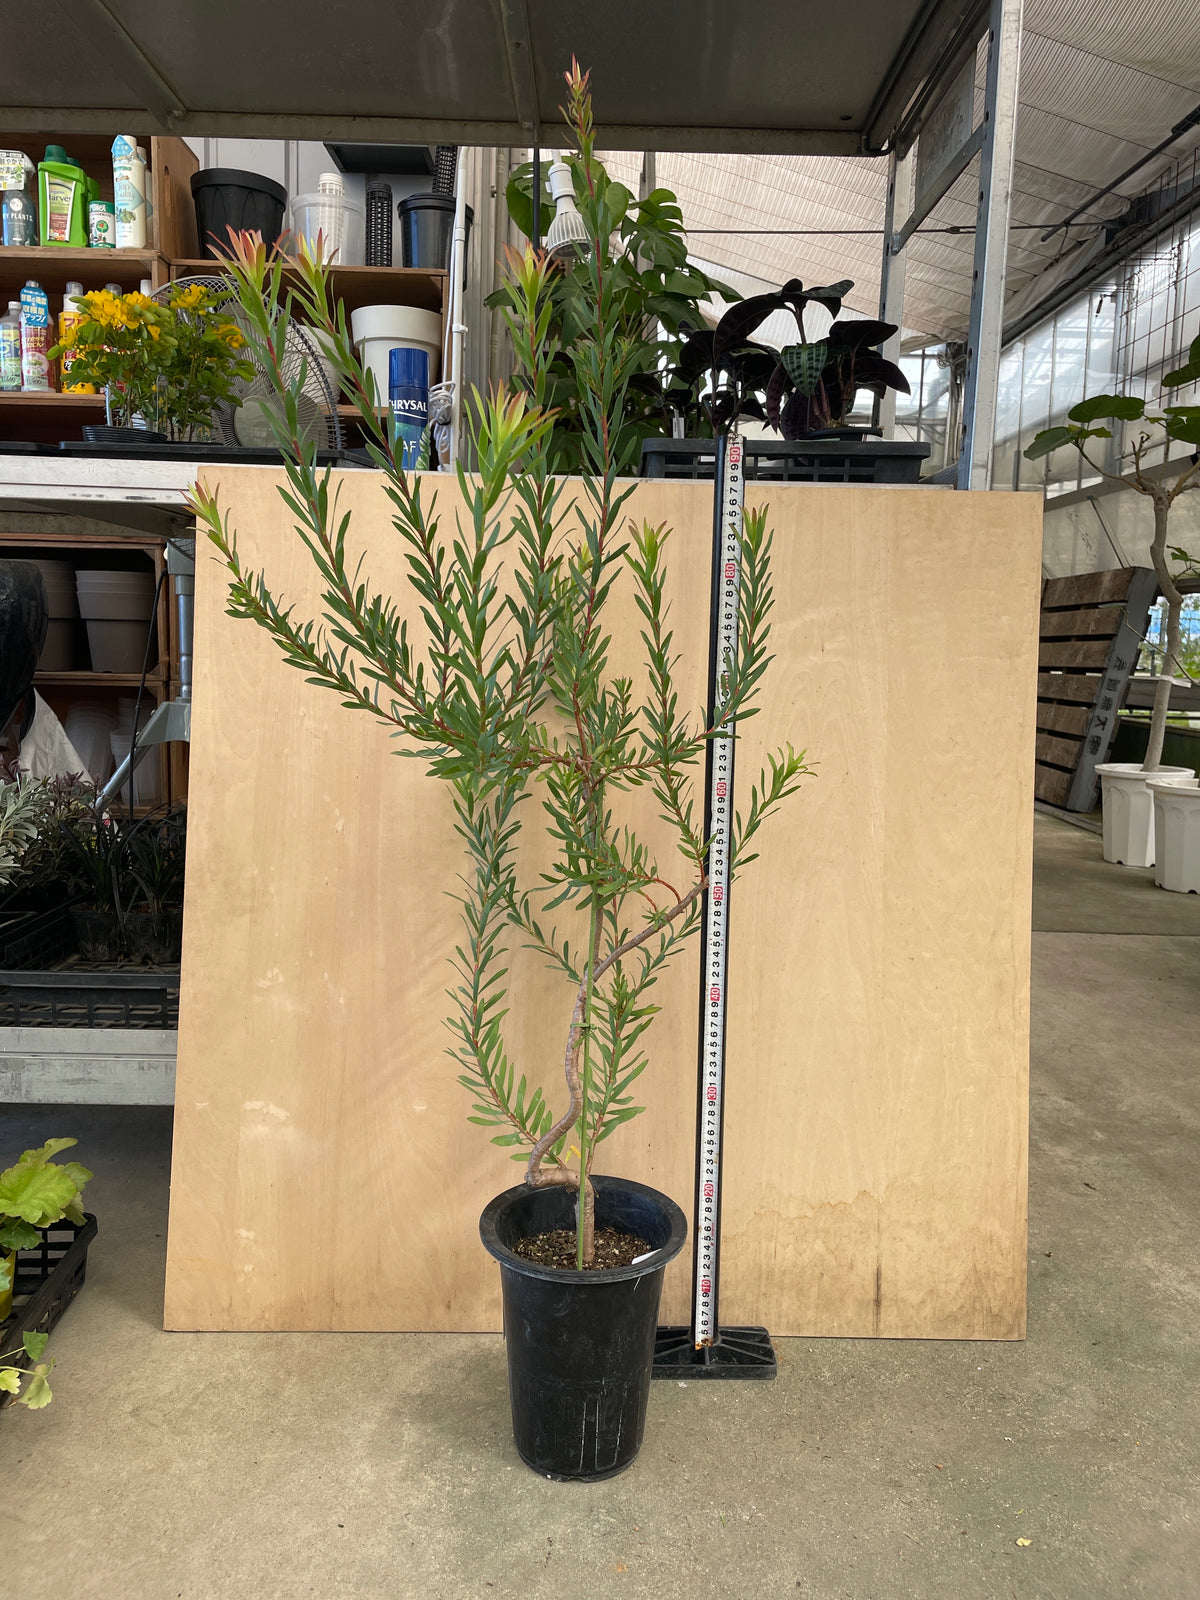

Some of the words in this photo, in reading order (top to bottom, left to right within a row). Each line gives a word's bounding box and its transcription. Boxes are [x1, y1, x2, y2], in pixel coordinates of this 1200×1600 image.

[10, 213, 33, 222] PLANTS
[389, 399, 428, 412] HRYSAL
[730, 448, 740, 462] 90
[725, 564, 735, 577] 80
[717, 783, 726, 795] 60
[713, 887, 723, 899] 50
[710, 989, 719, 1000] 40
[707, 1088, 716, 1099] 30
[705, 1185, 713, 1196] 20
[702, 1280, 710, 1291] 10
